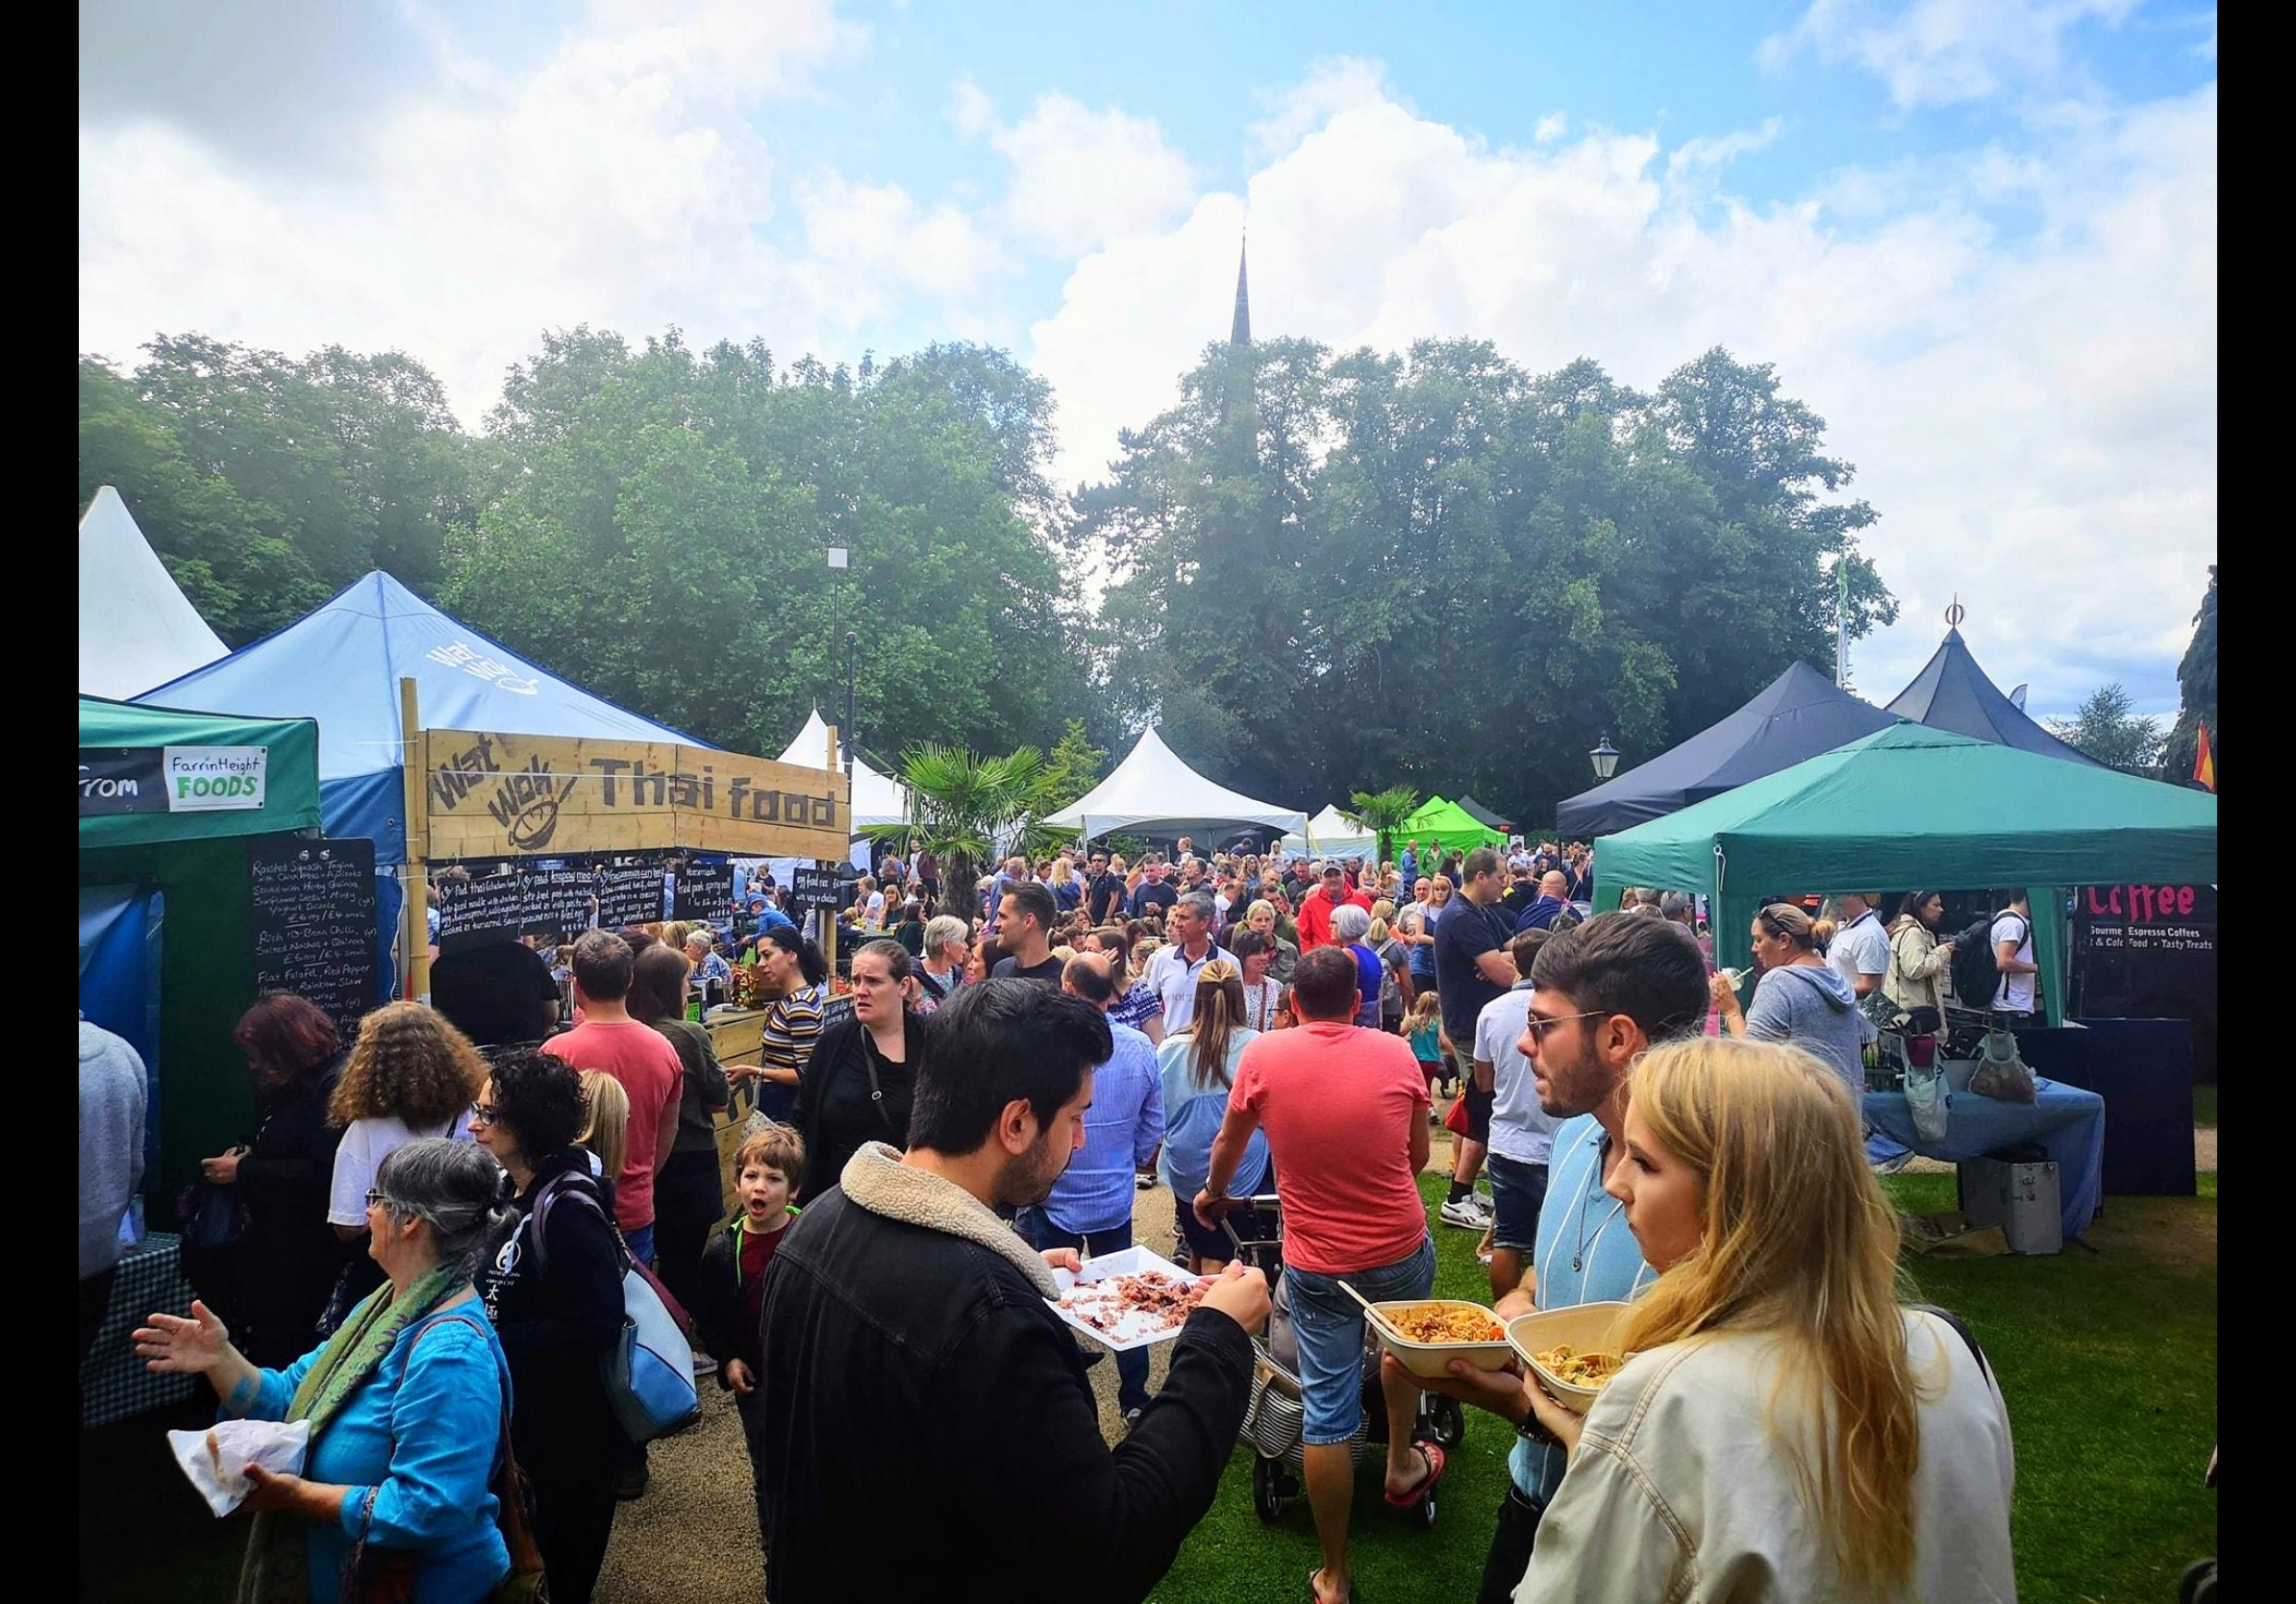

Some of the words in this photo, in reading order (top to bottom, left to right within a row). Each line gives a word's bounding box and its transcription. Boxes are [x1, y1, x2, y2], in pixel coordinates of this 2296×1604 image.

[177, 775, 259, 799] FOODS
[589, 757, 713, 810] Thai
[727, 776, 836, 828] food
[2090, 926, 2123, 937] Gourme
[2128, 926, 2166, 938] Espresso
[2167, 927, 2201, 938] Coffees
[2161, 940, 2184, 950] Tasty
[2185, 940, 2213, 950] Treats
